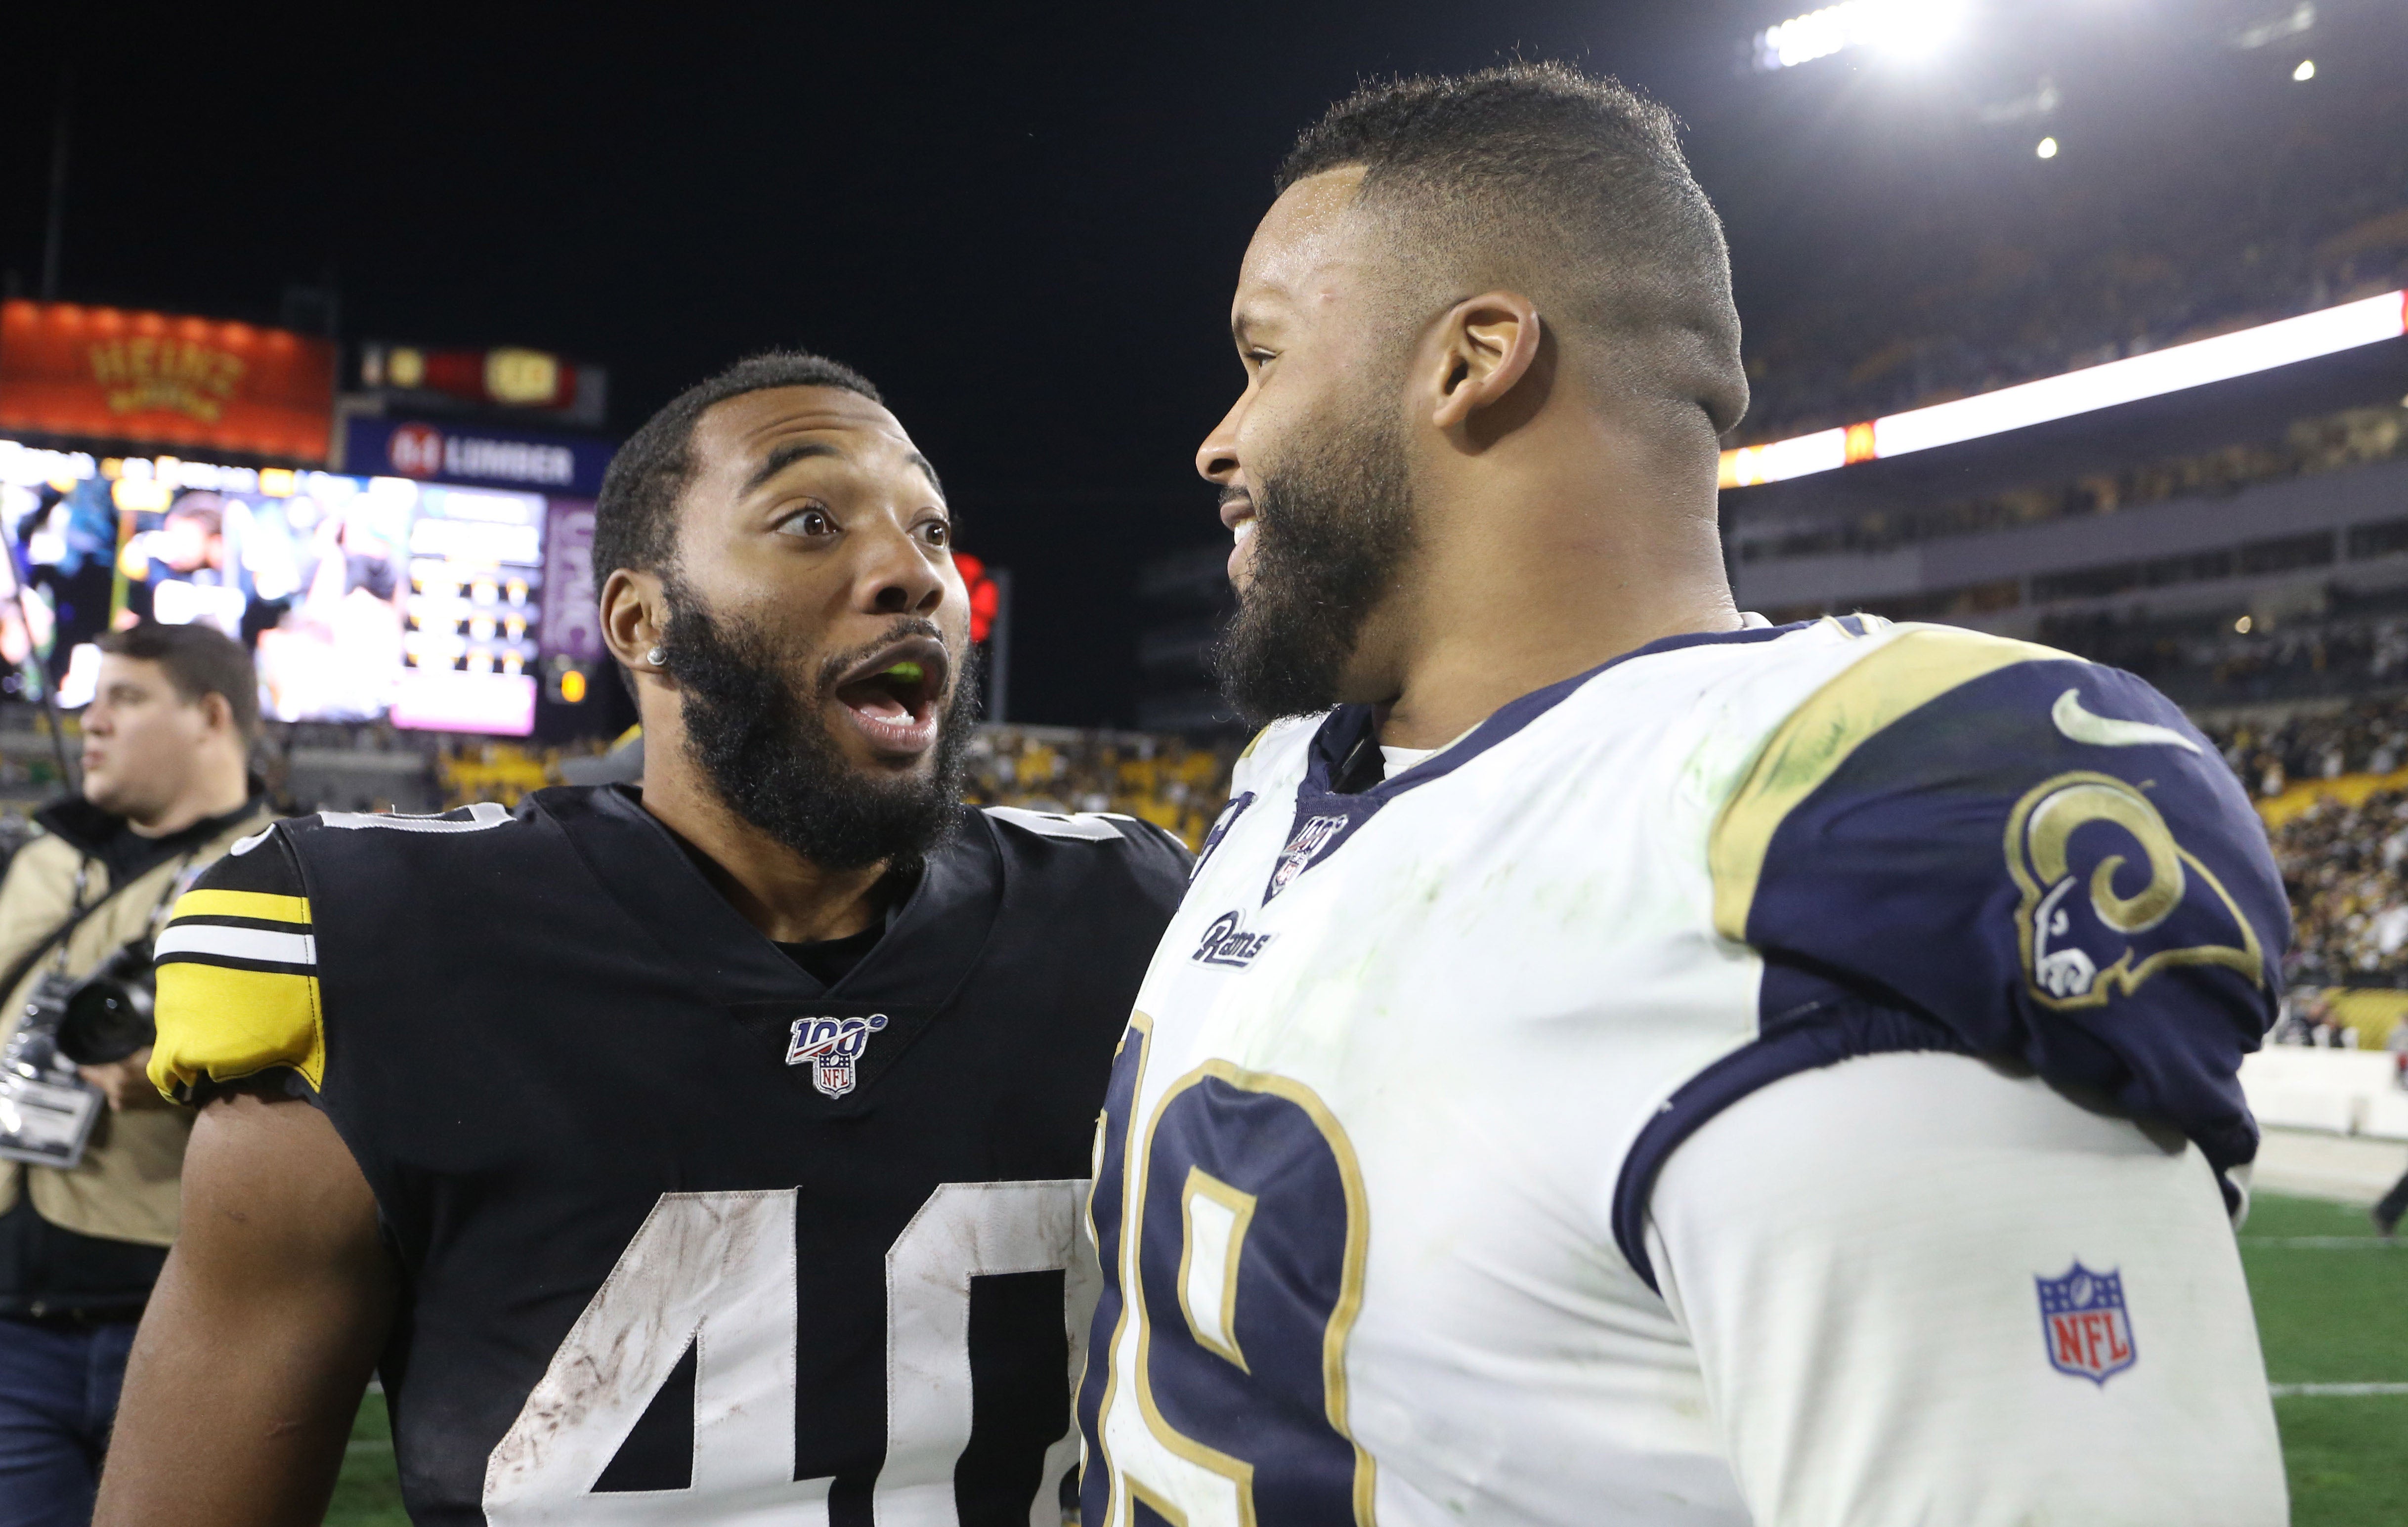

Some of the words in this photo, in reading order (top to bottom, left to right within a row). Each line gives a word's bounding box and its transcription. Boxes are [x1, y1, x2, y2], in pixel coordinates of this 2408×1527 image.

[445, 435, 575, 486] LUMBER
[1192, 910, 1272, 967] Rams
[795, 1021, 866, 1057] 100
[822, 1068, 848, 1089] NFL
[483, 1180, 1095, 1527] 40
[2053, 1312, 2130, 1370] NFL
